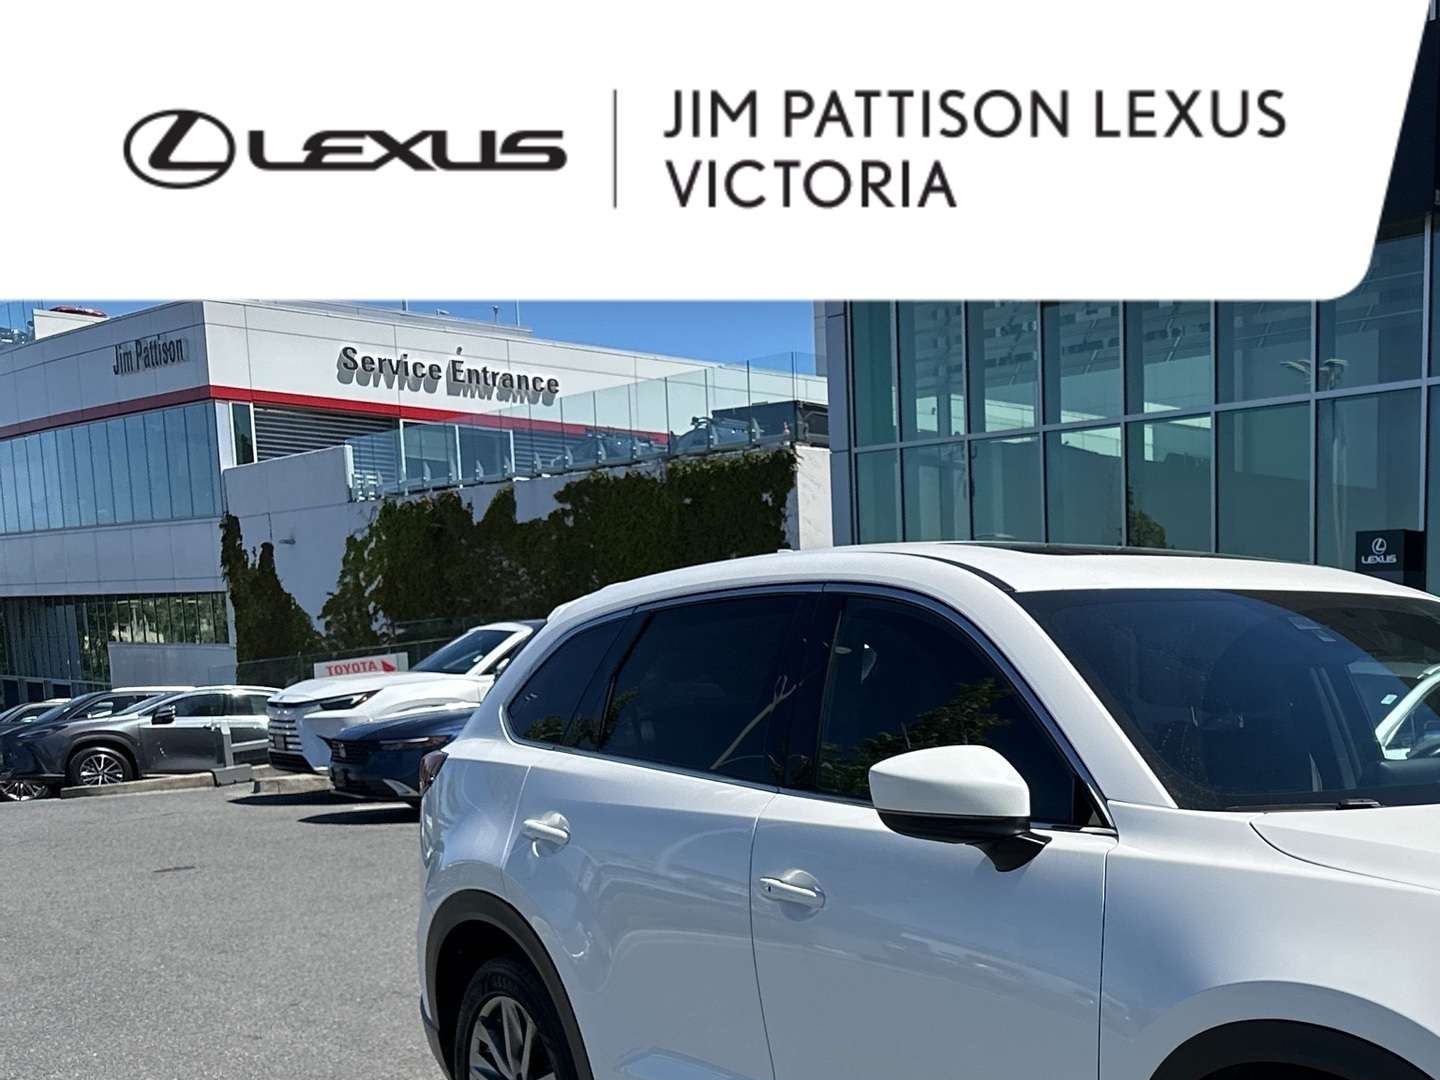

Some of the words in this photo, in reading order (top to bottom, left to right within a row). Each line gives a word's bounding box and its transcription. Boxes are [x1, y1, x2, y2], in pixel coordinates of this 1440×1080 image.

[113, 344, 133, 375] Jim
[136, 334, 184, 369] Pattison
[342, 346, 442, 380] Service
[450, 359, 559, 394] Entrance
[1361, 554, 1398, 564] LEXUS
[327, 660, 377, 676] TOYOTA
